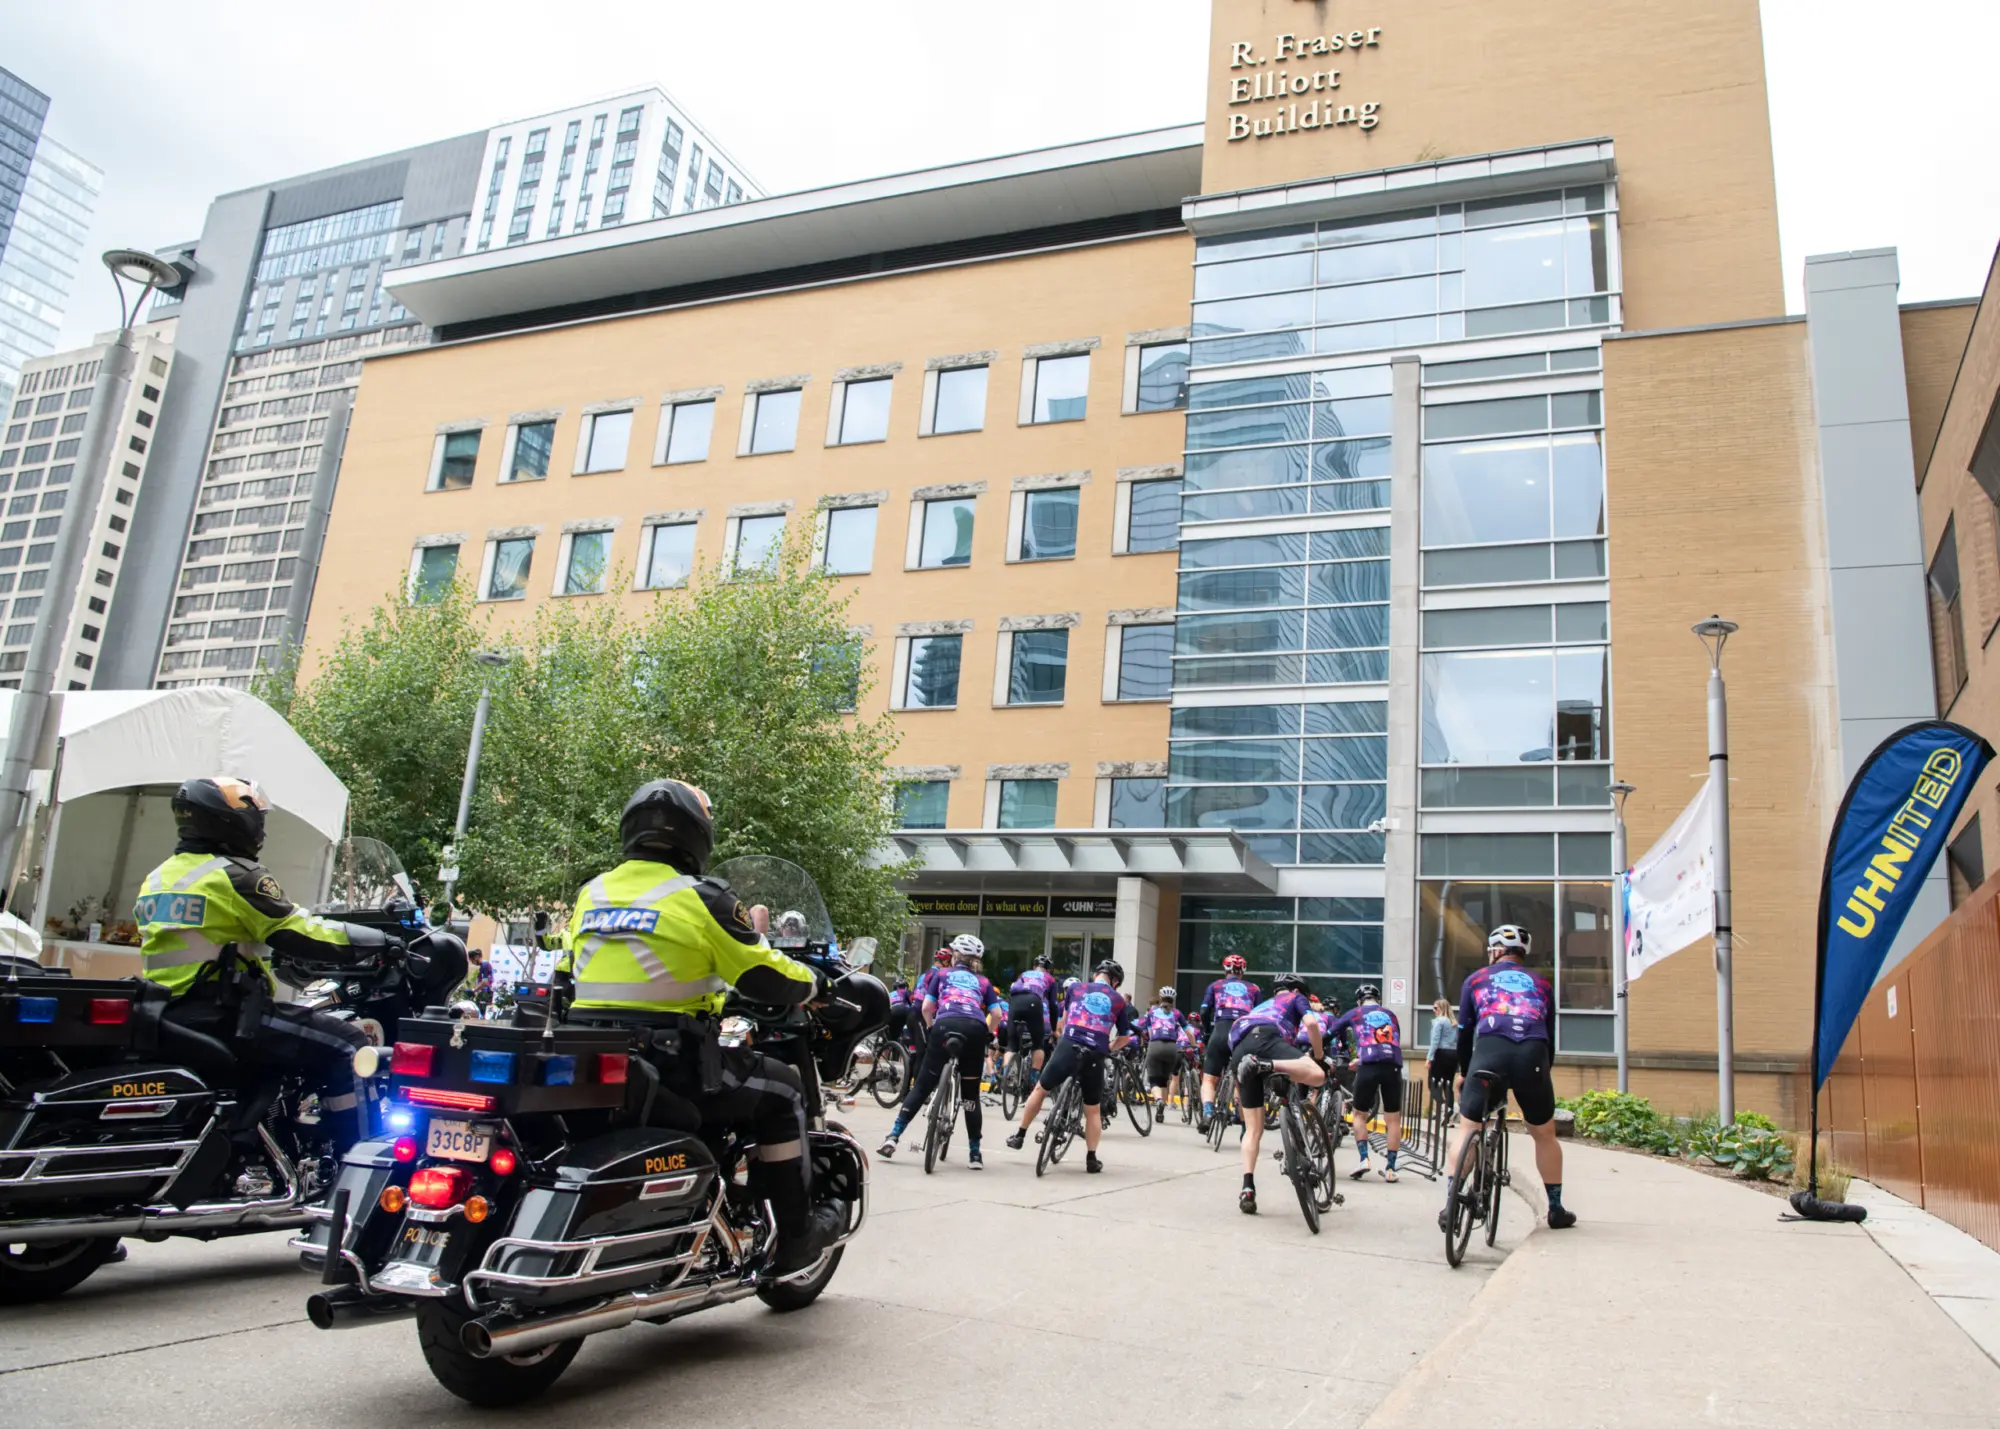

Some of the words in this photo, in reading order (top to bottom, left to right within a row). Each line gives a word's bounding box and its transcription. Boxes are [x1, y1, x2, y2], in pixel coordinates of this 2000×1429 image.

[1230, 41, 1266, 69] R.
[1274, 26, 1382, 62] Fraser
[1228, 68, 1341, 106] Elliott
[1226, 99, 1381, 143] Building
[1836, 747, 1962, 938] UHNITED
[132, 896, 202, 922] POCE
[935, 900, 956, 911] been
[957, 900, 979, 911] done
[985, 901, 994, 912] is
[995, 901, 1017, 912] what
[1019, 903, 1032, 912] we
[1032, 901, 1045, 912] do
[1072, 901, 1094, 912] UHN
[580, 910, 658, 932] POLICE
[112, 1081, 166, 1097] POLICE
[432, 1129, 484, 1153] 33C8P
[645, 1153, 687, 1174] POLICE
[403, 1227, 451, 1248] POLICE
